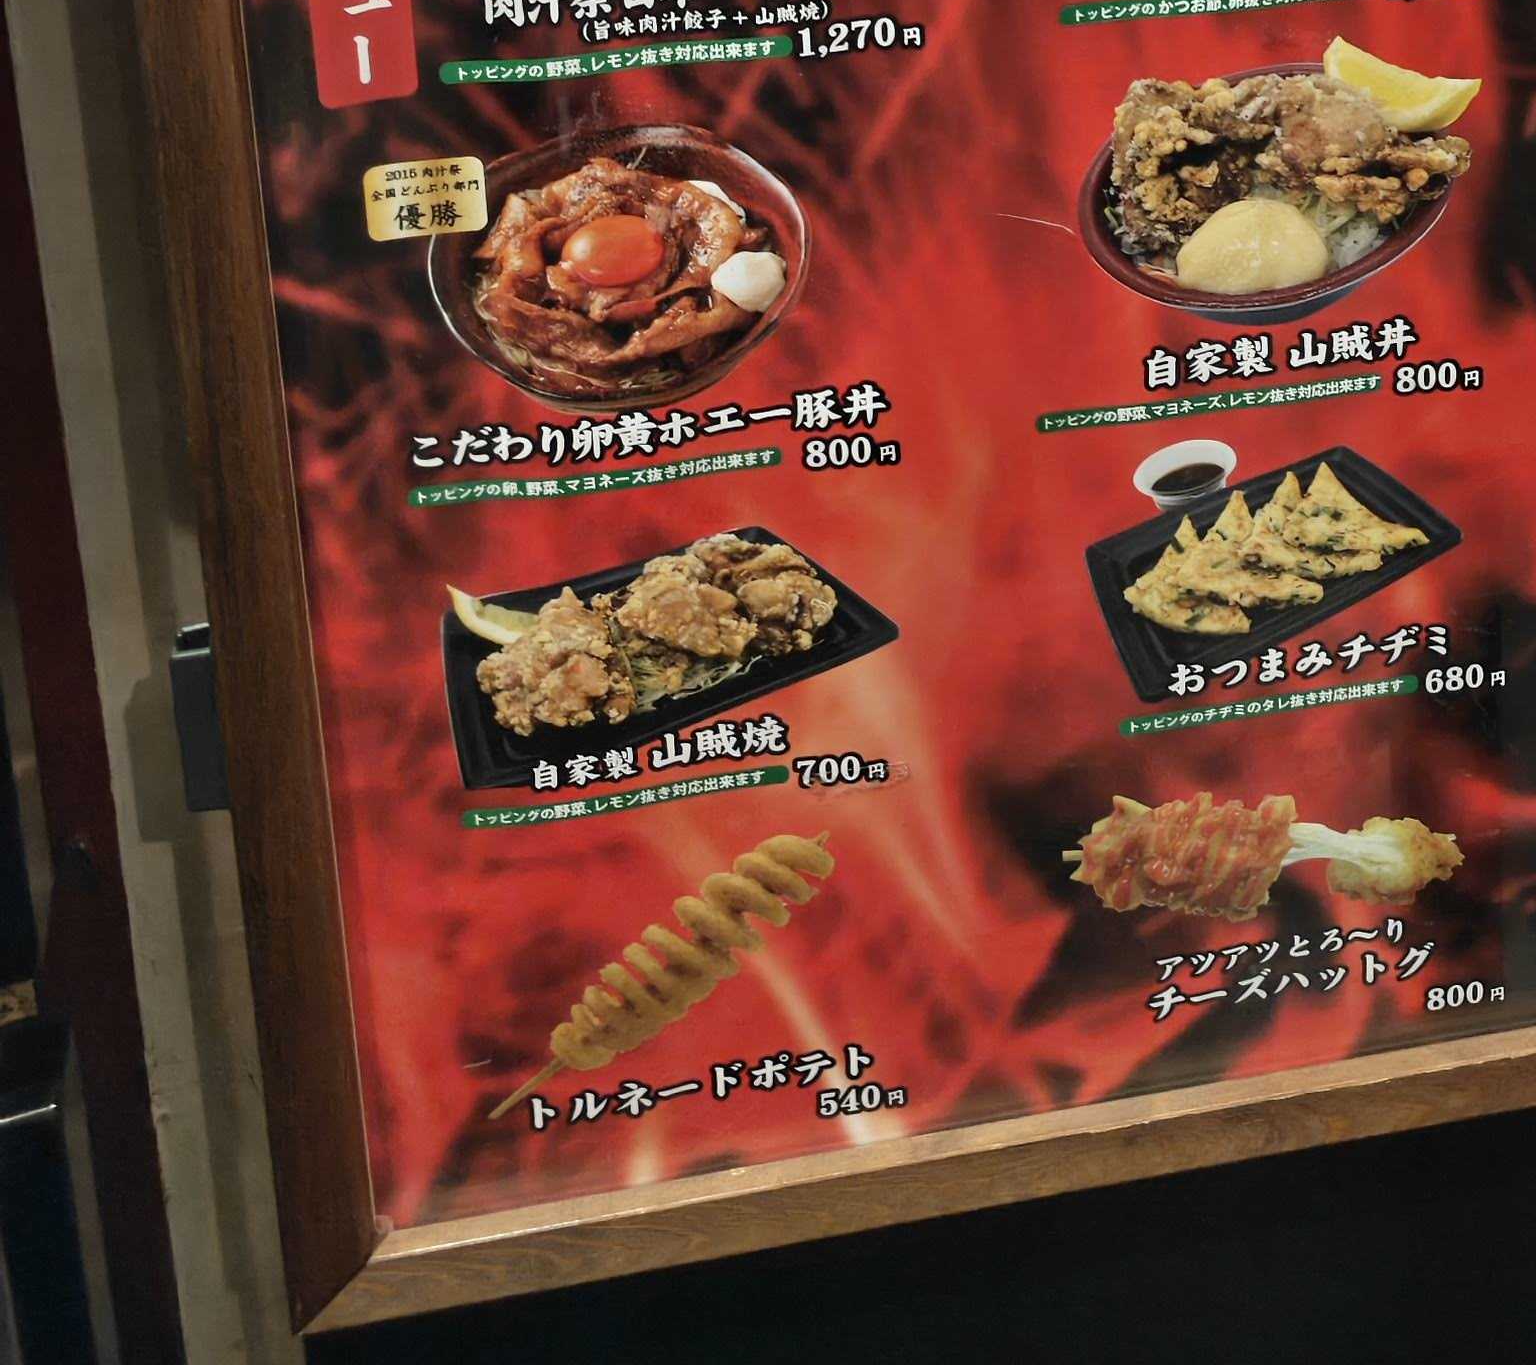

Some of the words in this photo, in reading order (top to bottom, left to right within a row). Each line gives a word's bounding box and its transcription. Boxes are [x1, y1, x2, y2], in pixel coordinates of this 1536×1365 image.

[582, 5, 829, 43] （旨味肉汁餃子＋山賊焼）
[798, 17, 922, 57] 1,270円
[394, 200, 462, 231] 優勝
[1147, 335, 1270, 387] 自家製
[1290, 319, 1416, 366] 山賊丼
[1396, 363, 1480, 393] 800円
[412, 385, 887, 467] こだわり卵黄ホエー豚丼
[805, 437, 897, 468] 800円
[1168, 626, 1449, 696] おつまみチヂミ
[1425, 664, 1506, 694] 680円
[532, 747, 638, 791] 自家製
[653, 717, 787, 768] 山賊焼
[796, 756, 885, 787] 700円
[1149, 941, 1435, 1020] チーズハットグ
[1427, 981, 1504, 1011] 800円
[531, 1047, 872, 1129] トルネードポテト
[820, 1085, 904, 1115] 540円
